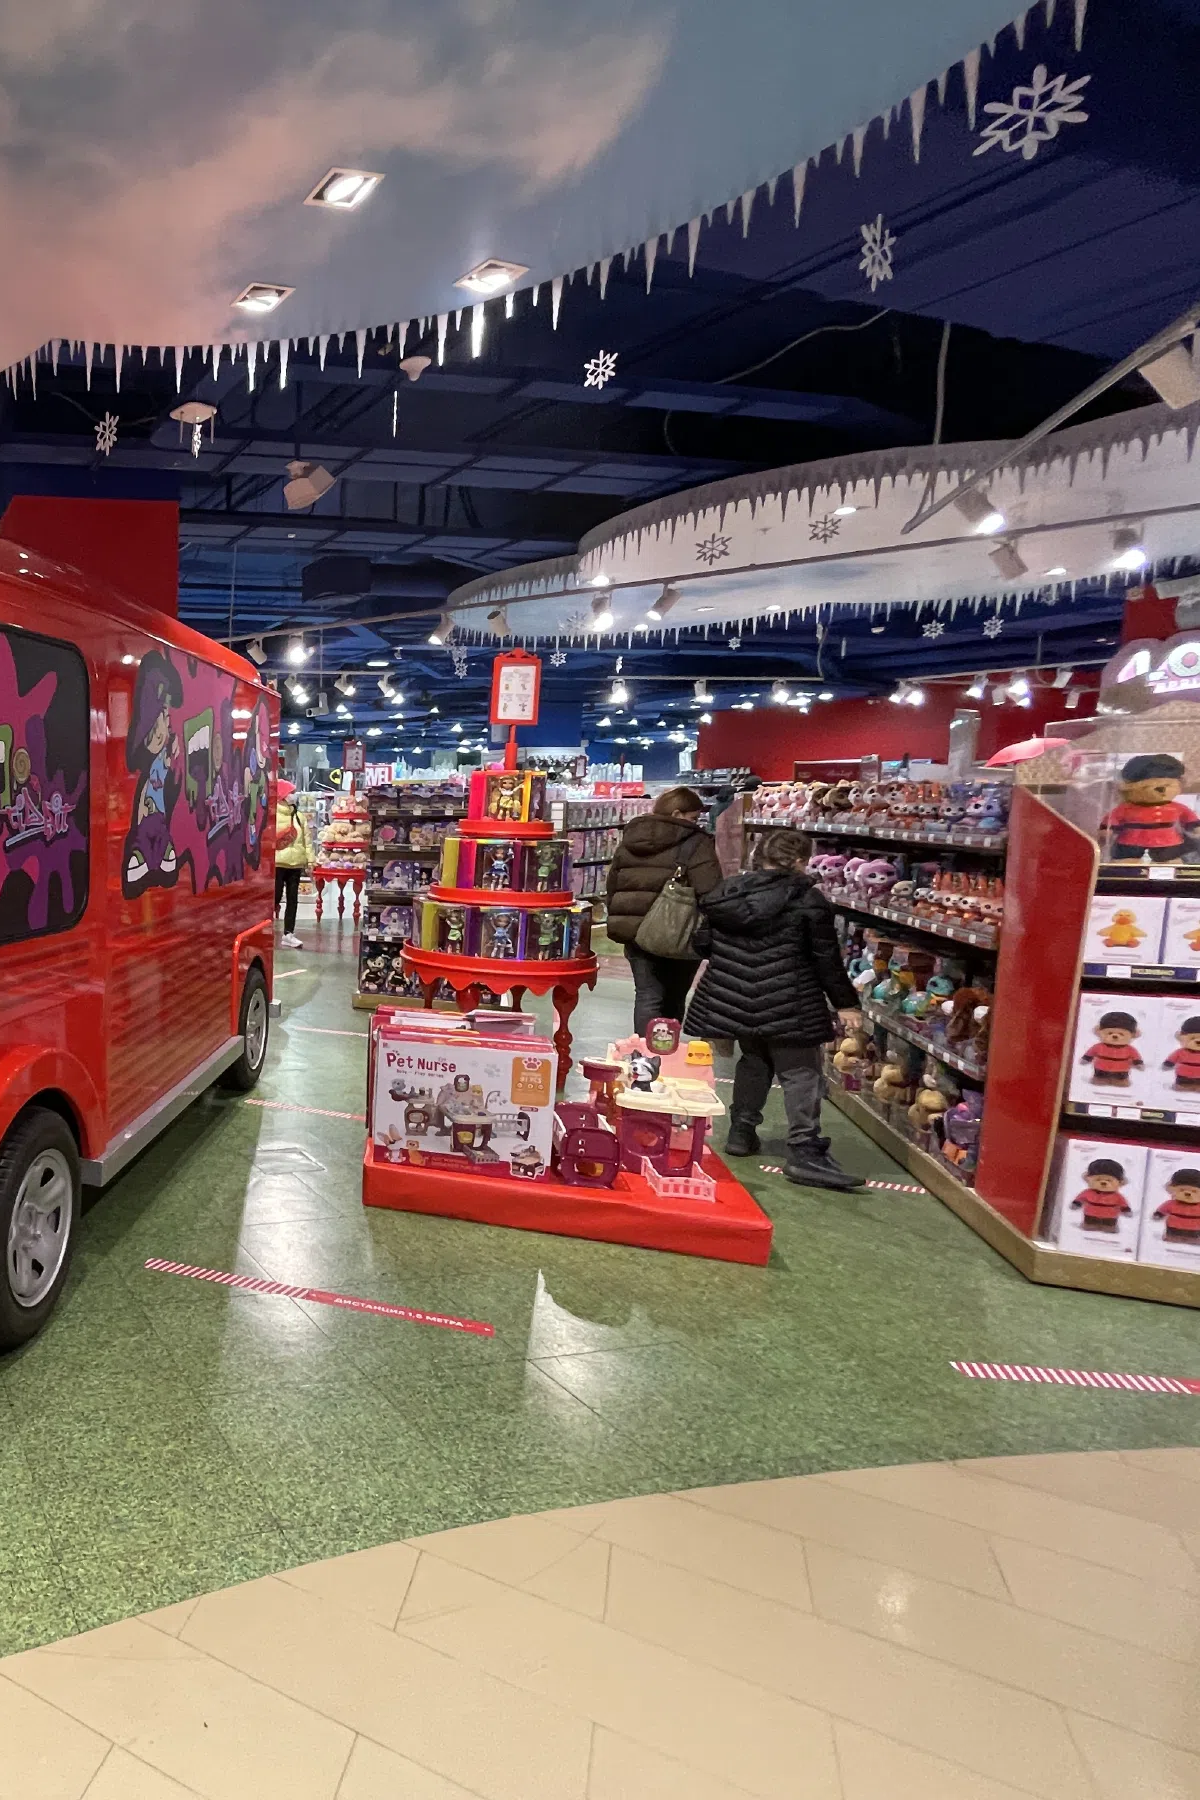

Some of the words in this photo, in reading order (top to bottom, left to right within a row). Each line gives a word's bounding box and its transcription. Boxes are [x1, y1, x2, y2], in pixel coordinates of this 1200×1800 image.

[386, 1052, 413, 1069] Pet
[417, 1057, 457, 1073] Nurse
[333, 1297, 405, 1316] ДИСТАНЦИЯ
[425, 1314, 464, 1328] МЕТРА
